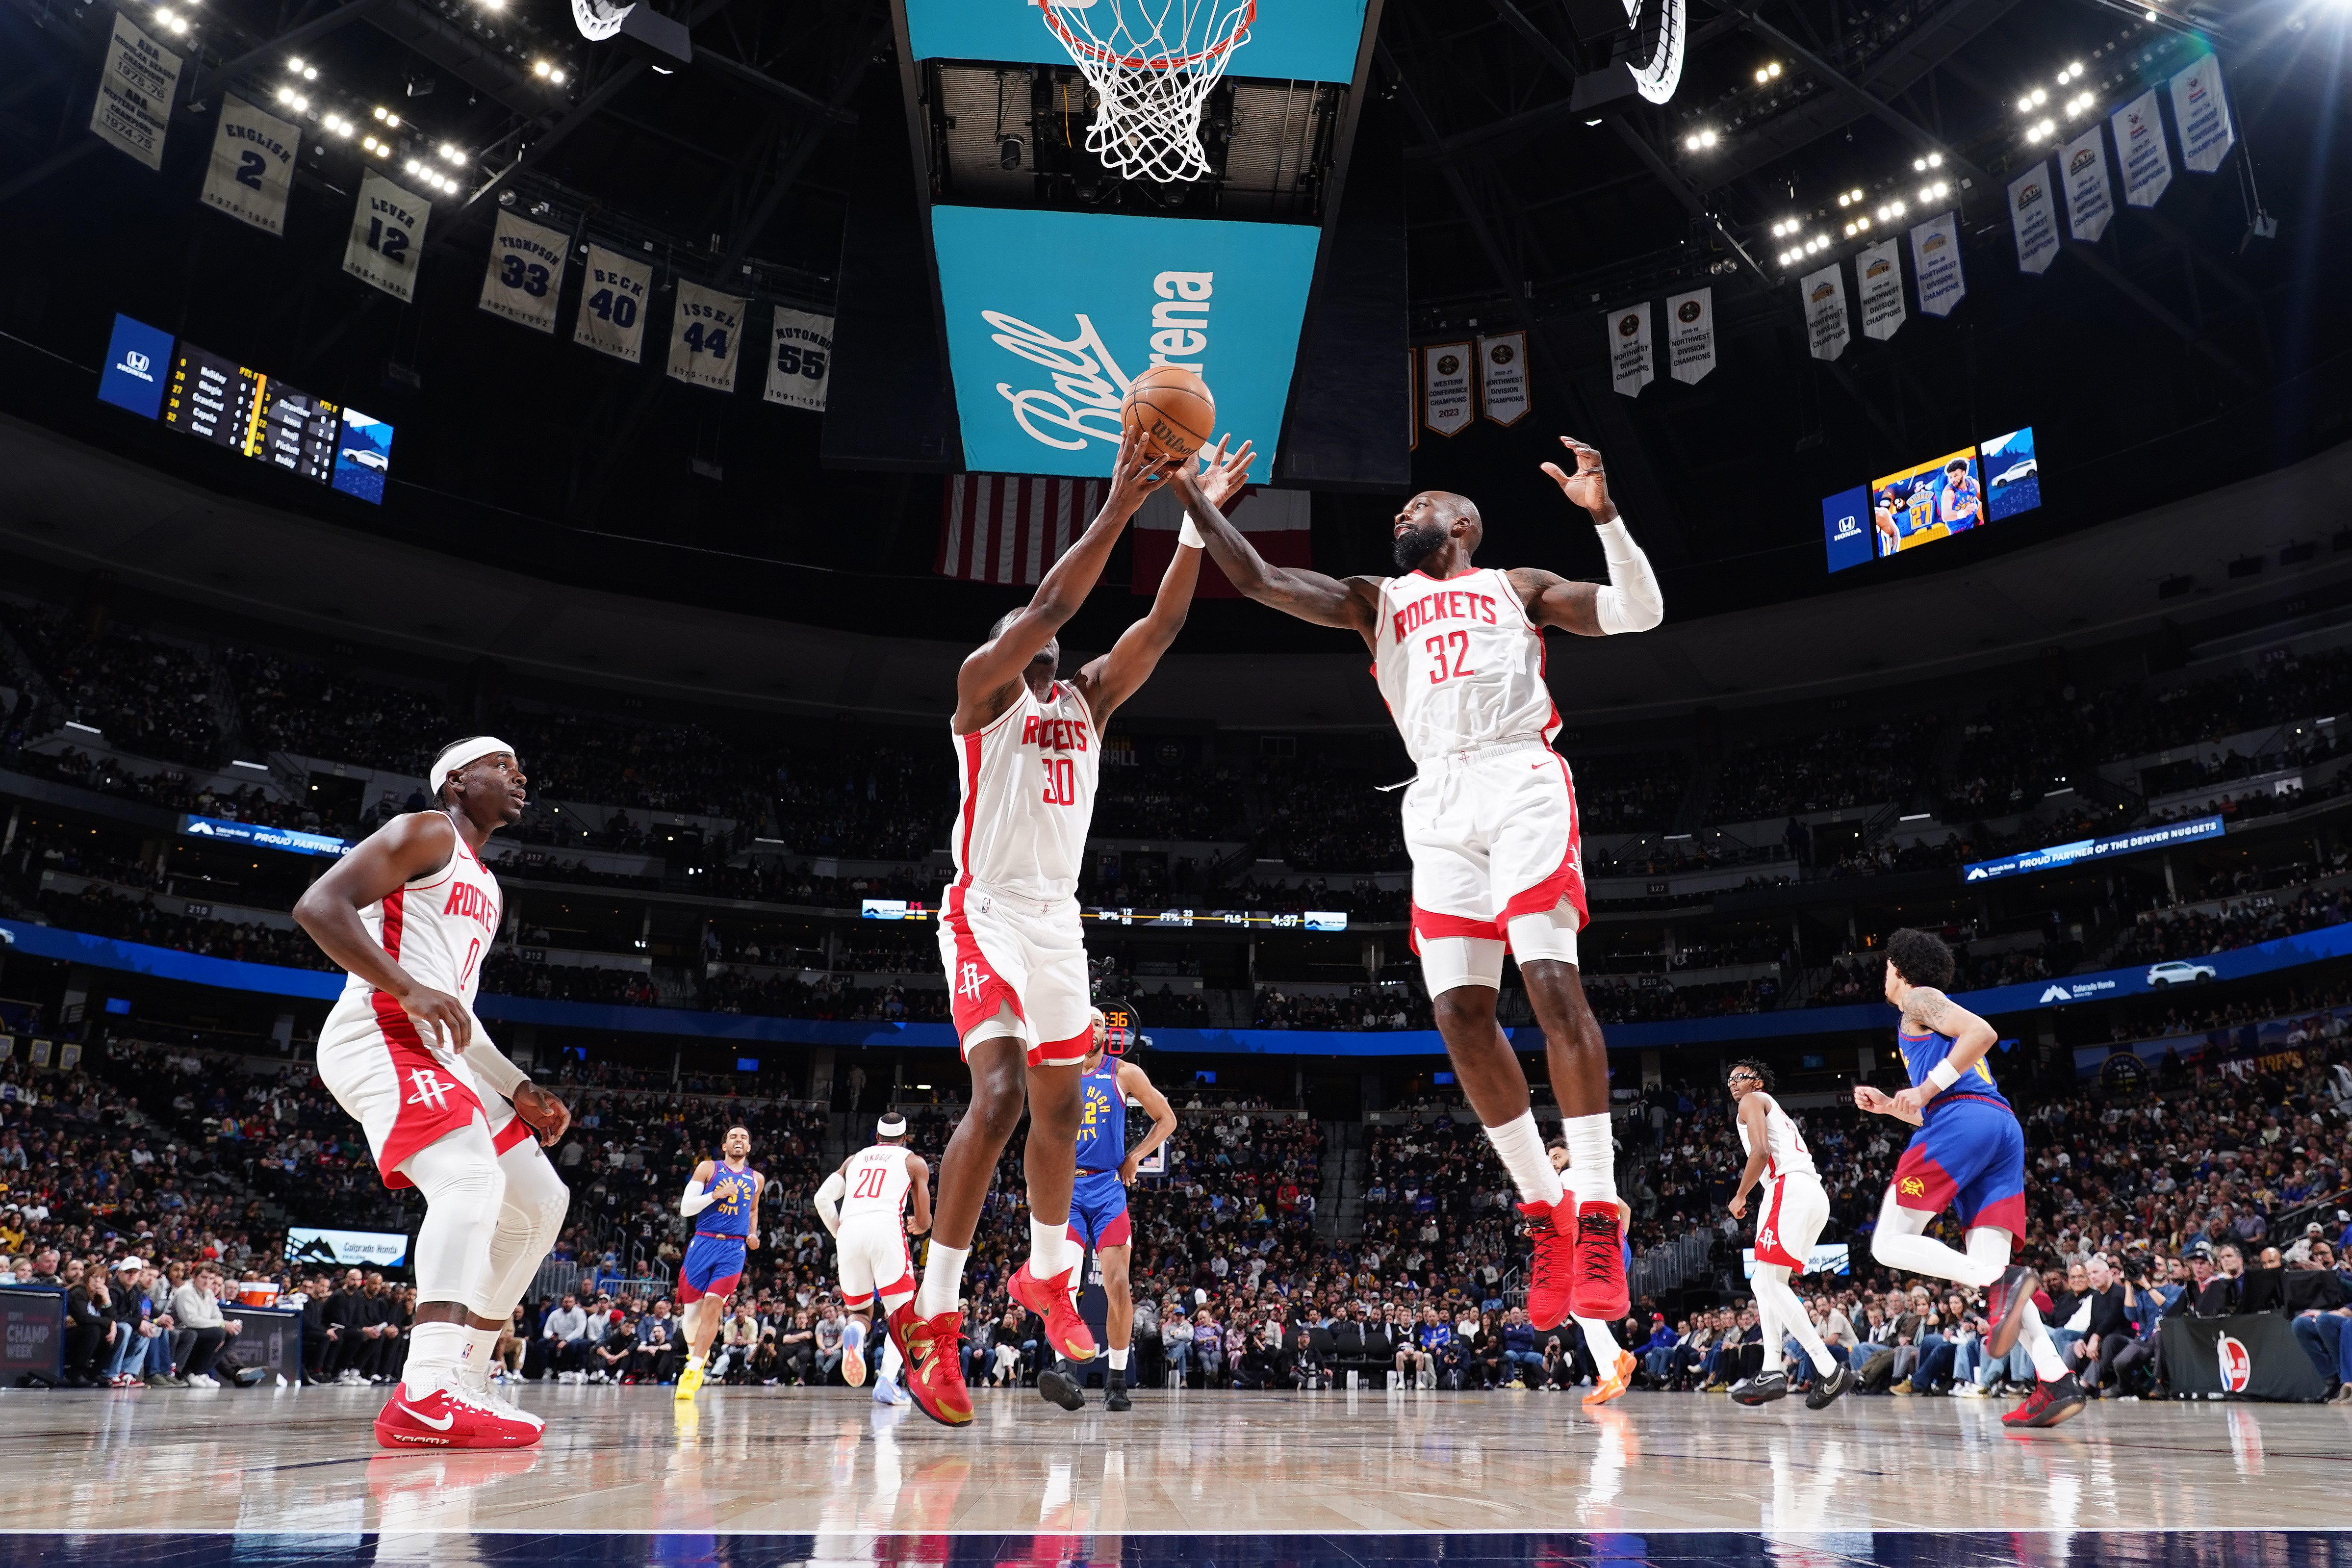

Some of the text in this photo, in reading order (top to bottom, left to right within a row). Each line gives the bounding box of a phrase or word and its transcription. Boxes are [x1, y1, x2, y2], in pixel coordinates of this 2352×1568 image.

[225, 123, 291, 163] ENGLISH
[235, 150, 266, 191] 2
[371, 197, 414, 229] LEVER
[367, 216, 409, 264] 12
[499, 236, 560, 266] THOMPSON
[500, 255, 549, 298] 33
[1920, 260, 1957, 282] NORTHWEST
[594, 269, 643, 297] BECK
[1927, 273, 1953, 290] DIVISION
[1864, 285, 1899, 306] NORTHWEST
[1924, 282, 1960, 302] CHAMPIONS
[589, 288, 637, 329] 40
[683, 304, 736, 329] ISSEL
[1866, 307, 1902, 326] CHAMPIONS
[1870, 299, 1895, 314] DIVISION
[1149, 270, 1214, 378] rena
[1810, 308, 1843, 329] NORTHWEST
[1816, 321, 1841, 336] DIVISION
[684, 322, 728, 359] 44
[775, 327, 833, 350] MUTOMBO
[1672, 333, 1710, 347] NORTHWEST
[1813, 328, 1845, 348] CHAMPIONS
[1674, 352, 1711, 366] CHAMPIONS
[1677, 344, 1706, 356] DIVISION
[778, 343, 825, 380] 55
[116, 362, 153, 383] HONDA
[674, 366, 730, 386] 1975-1985
[981, 310, 1130, 451] Ball
[1434, 378, 1463, 387] WESTERN
[1486, 376, 1523, 386] NORTHWEST
[240, 383, 246, 391] 0
[1429, 386, 1468, 397] CONFERENCE
[1431, 396, 1467, 406] CHAMPIONS
[1488, 395, 1524, 405] CHAMPIONS
[234, 410, 241, 418] 4
[245, 413, 252, 422] 0
[265, 393, 271, 401] 3
[320, 415, 326, 424] 0
[330, 419, 336, 428] 0
[1439, 408, 1459, 418] 2023
[232, 422, 238, 431] 7
[318, 429, 324, 437] 2
[328, 432, 334, 441] 0
[230, 436, 236, 445] 0
[240, 440, 246, 449] 0
[315, 441, 322, 450] 0
[313, 454, 330, 466] 3 0
[311, 467, 327, 480] 0 0
[1911, 502, 1931, 527] 27
[1834, 527, 1862, 541] HONDA
[1393, 591, 1497, 646] ROCKETS
[1426, 630, 1475, 685] 32
[1042, 759, 1074, 806] 30
[254, 832, 351, 855] PROUD PARTNER O
[2020, 822, 2217, 869] PROUD PARTNER OF THE DENVER NUGGETS
[444, 881, 498, 939] ROCKET
[1099, 911, 1119, 920] 3P%
[1160, 913, 1180, 922] FT%
[1224, 914, 1241, 923] FLS
[1271, 914, 1298, 927] 4:37
[460, 937, 480, 991] 0
[1104, 1012, 1128, 1027] :36
[1086, 1085, 1110, 1113] HIGH
[1081, 1102, 1097, 1124] 2
[1076, 1127, 1098, 1141] ITY
[864, 1153, 893, 1163] OKOGIE
[737, 1179, 751, 1200] HIGH
[853, 1168, 887, 1199] 20
[718, 1203, 738, 1215] CITY
[6, 1324, 50, 1343] CHAMP
